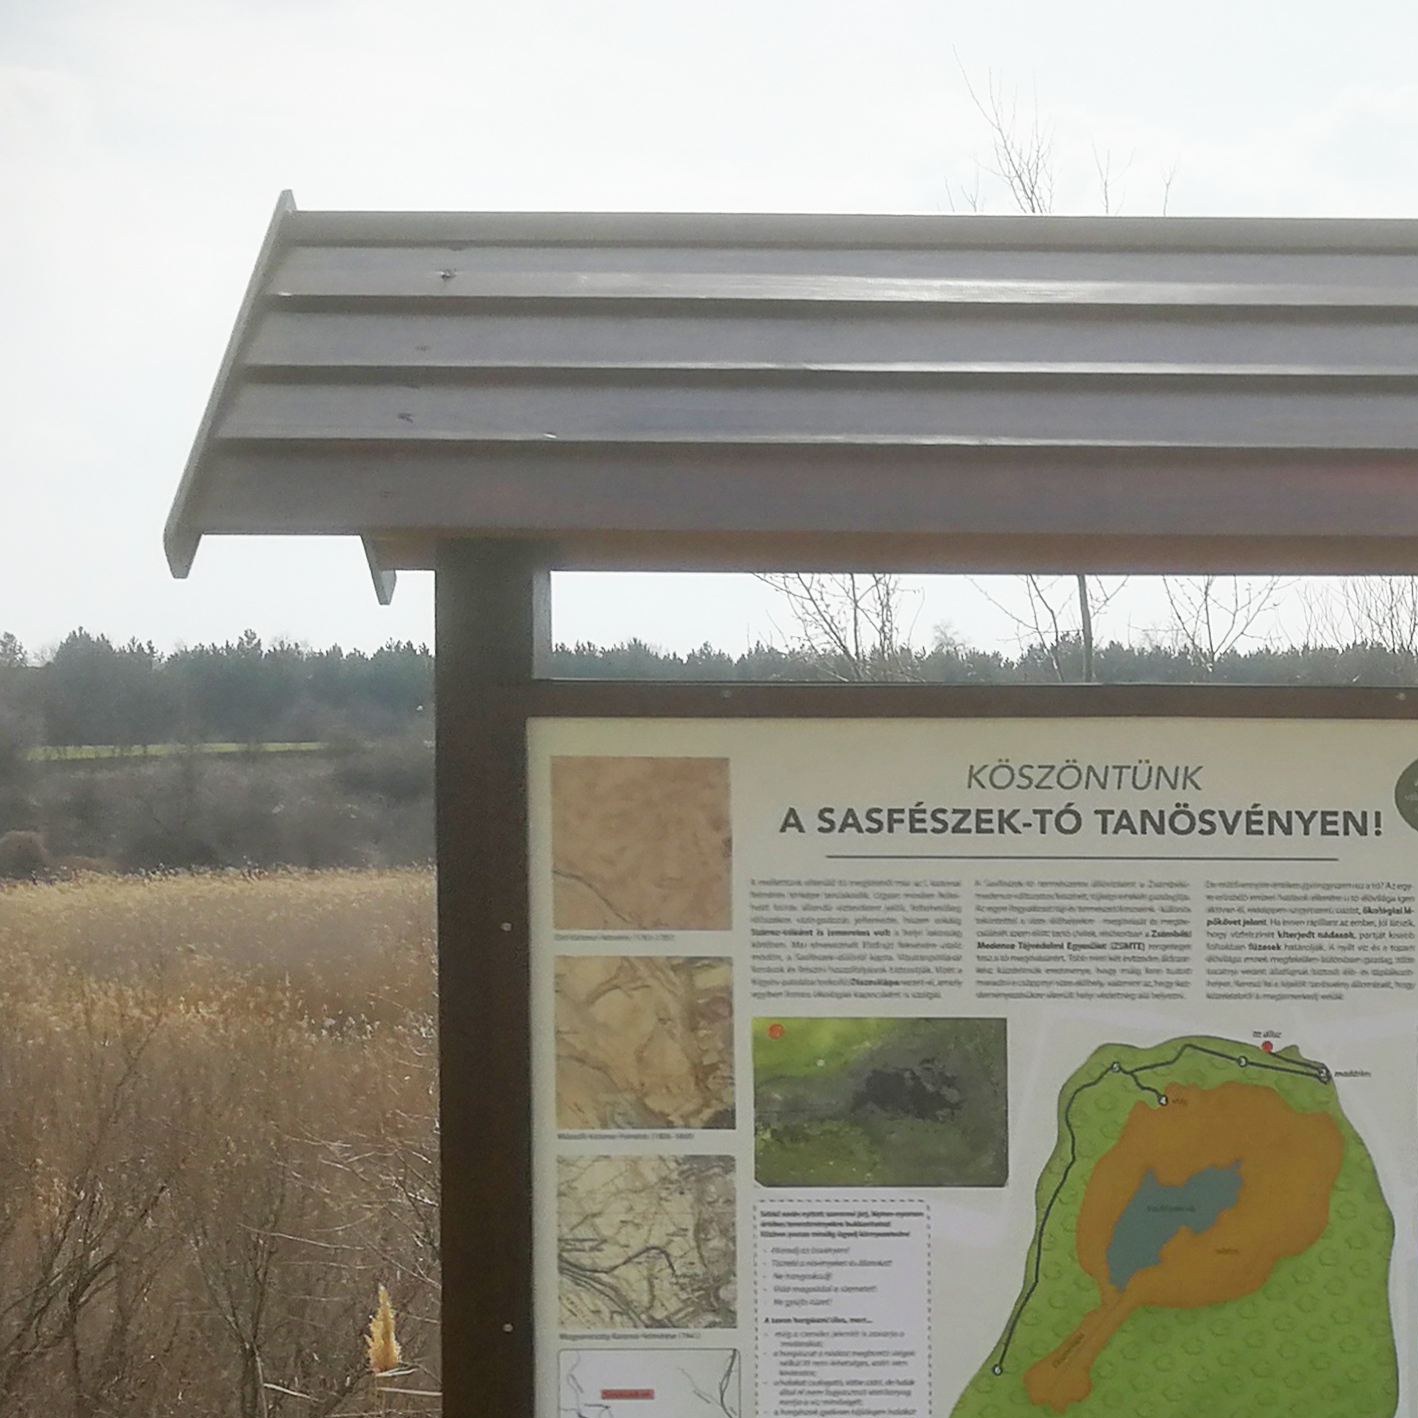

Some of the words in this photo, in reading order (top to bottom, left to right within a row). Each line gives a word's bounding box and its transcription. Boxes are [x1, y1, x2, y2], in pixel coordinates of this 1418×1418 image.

[966, 757, 1204, 792] KÖSZÖNTÜNK
[778, 806, 806, 834] A
[816, 800, 1083, 836] SASFÉSZEK-TÓ
[1093, 801, 1384, 837] TANÖSVÉNYEN!
